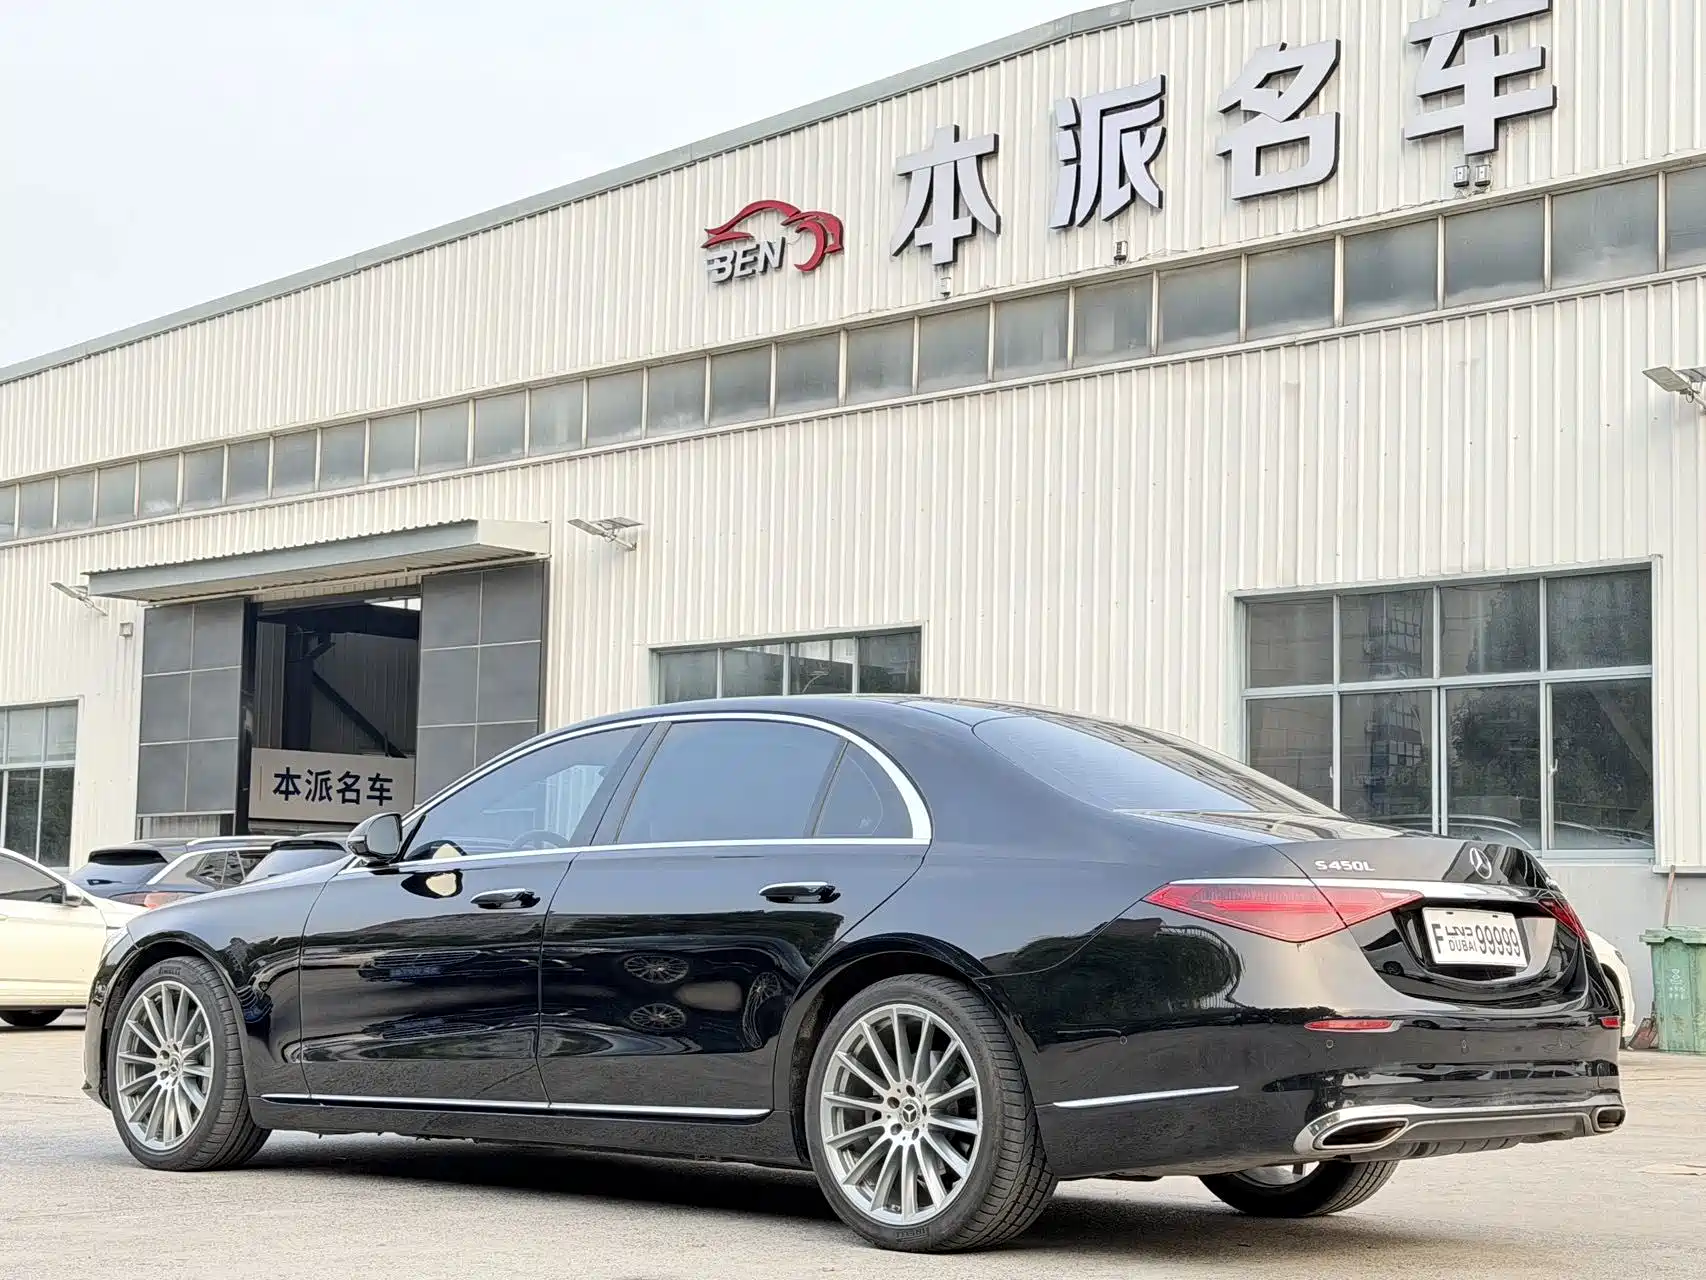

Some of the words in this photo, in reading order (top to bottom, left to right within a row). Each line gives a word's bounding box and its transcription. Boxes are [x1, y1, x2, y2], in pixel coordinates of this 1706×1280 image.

[890, 0, 1557, 265] 本派名车
[272, 766, 394, 806] 本派名车
[1314, 860, 1376, 872] S450L
[1431, 923, 1444, 955] F
[1448, 939, 1477, 952] DUBAI
[1475, 924, 1521, 957] 99999
